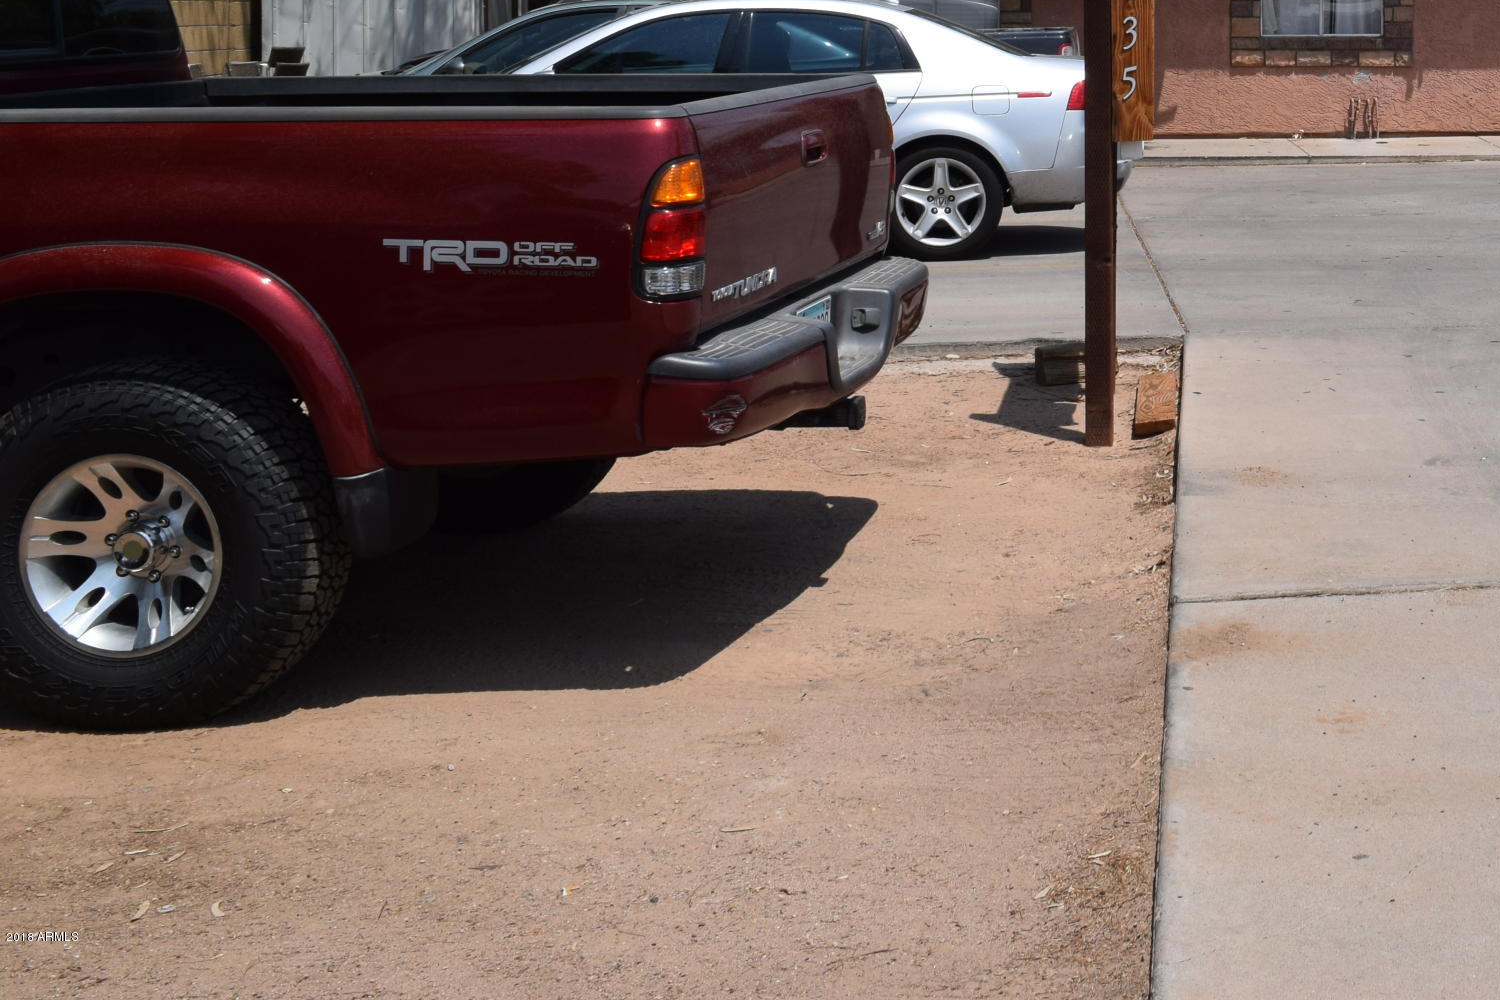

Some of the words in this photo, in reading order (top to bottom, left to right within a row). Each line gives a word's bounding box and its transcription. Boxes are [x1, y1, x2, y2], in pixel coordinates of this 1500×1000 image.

[513, 241, 575, 253] OFF
[382, 238, 508, 272] TRD
[513, 254, 598, 268] ROAD
